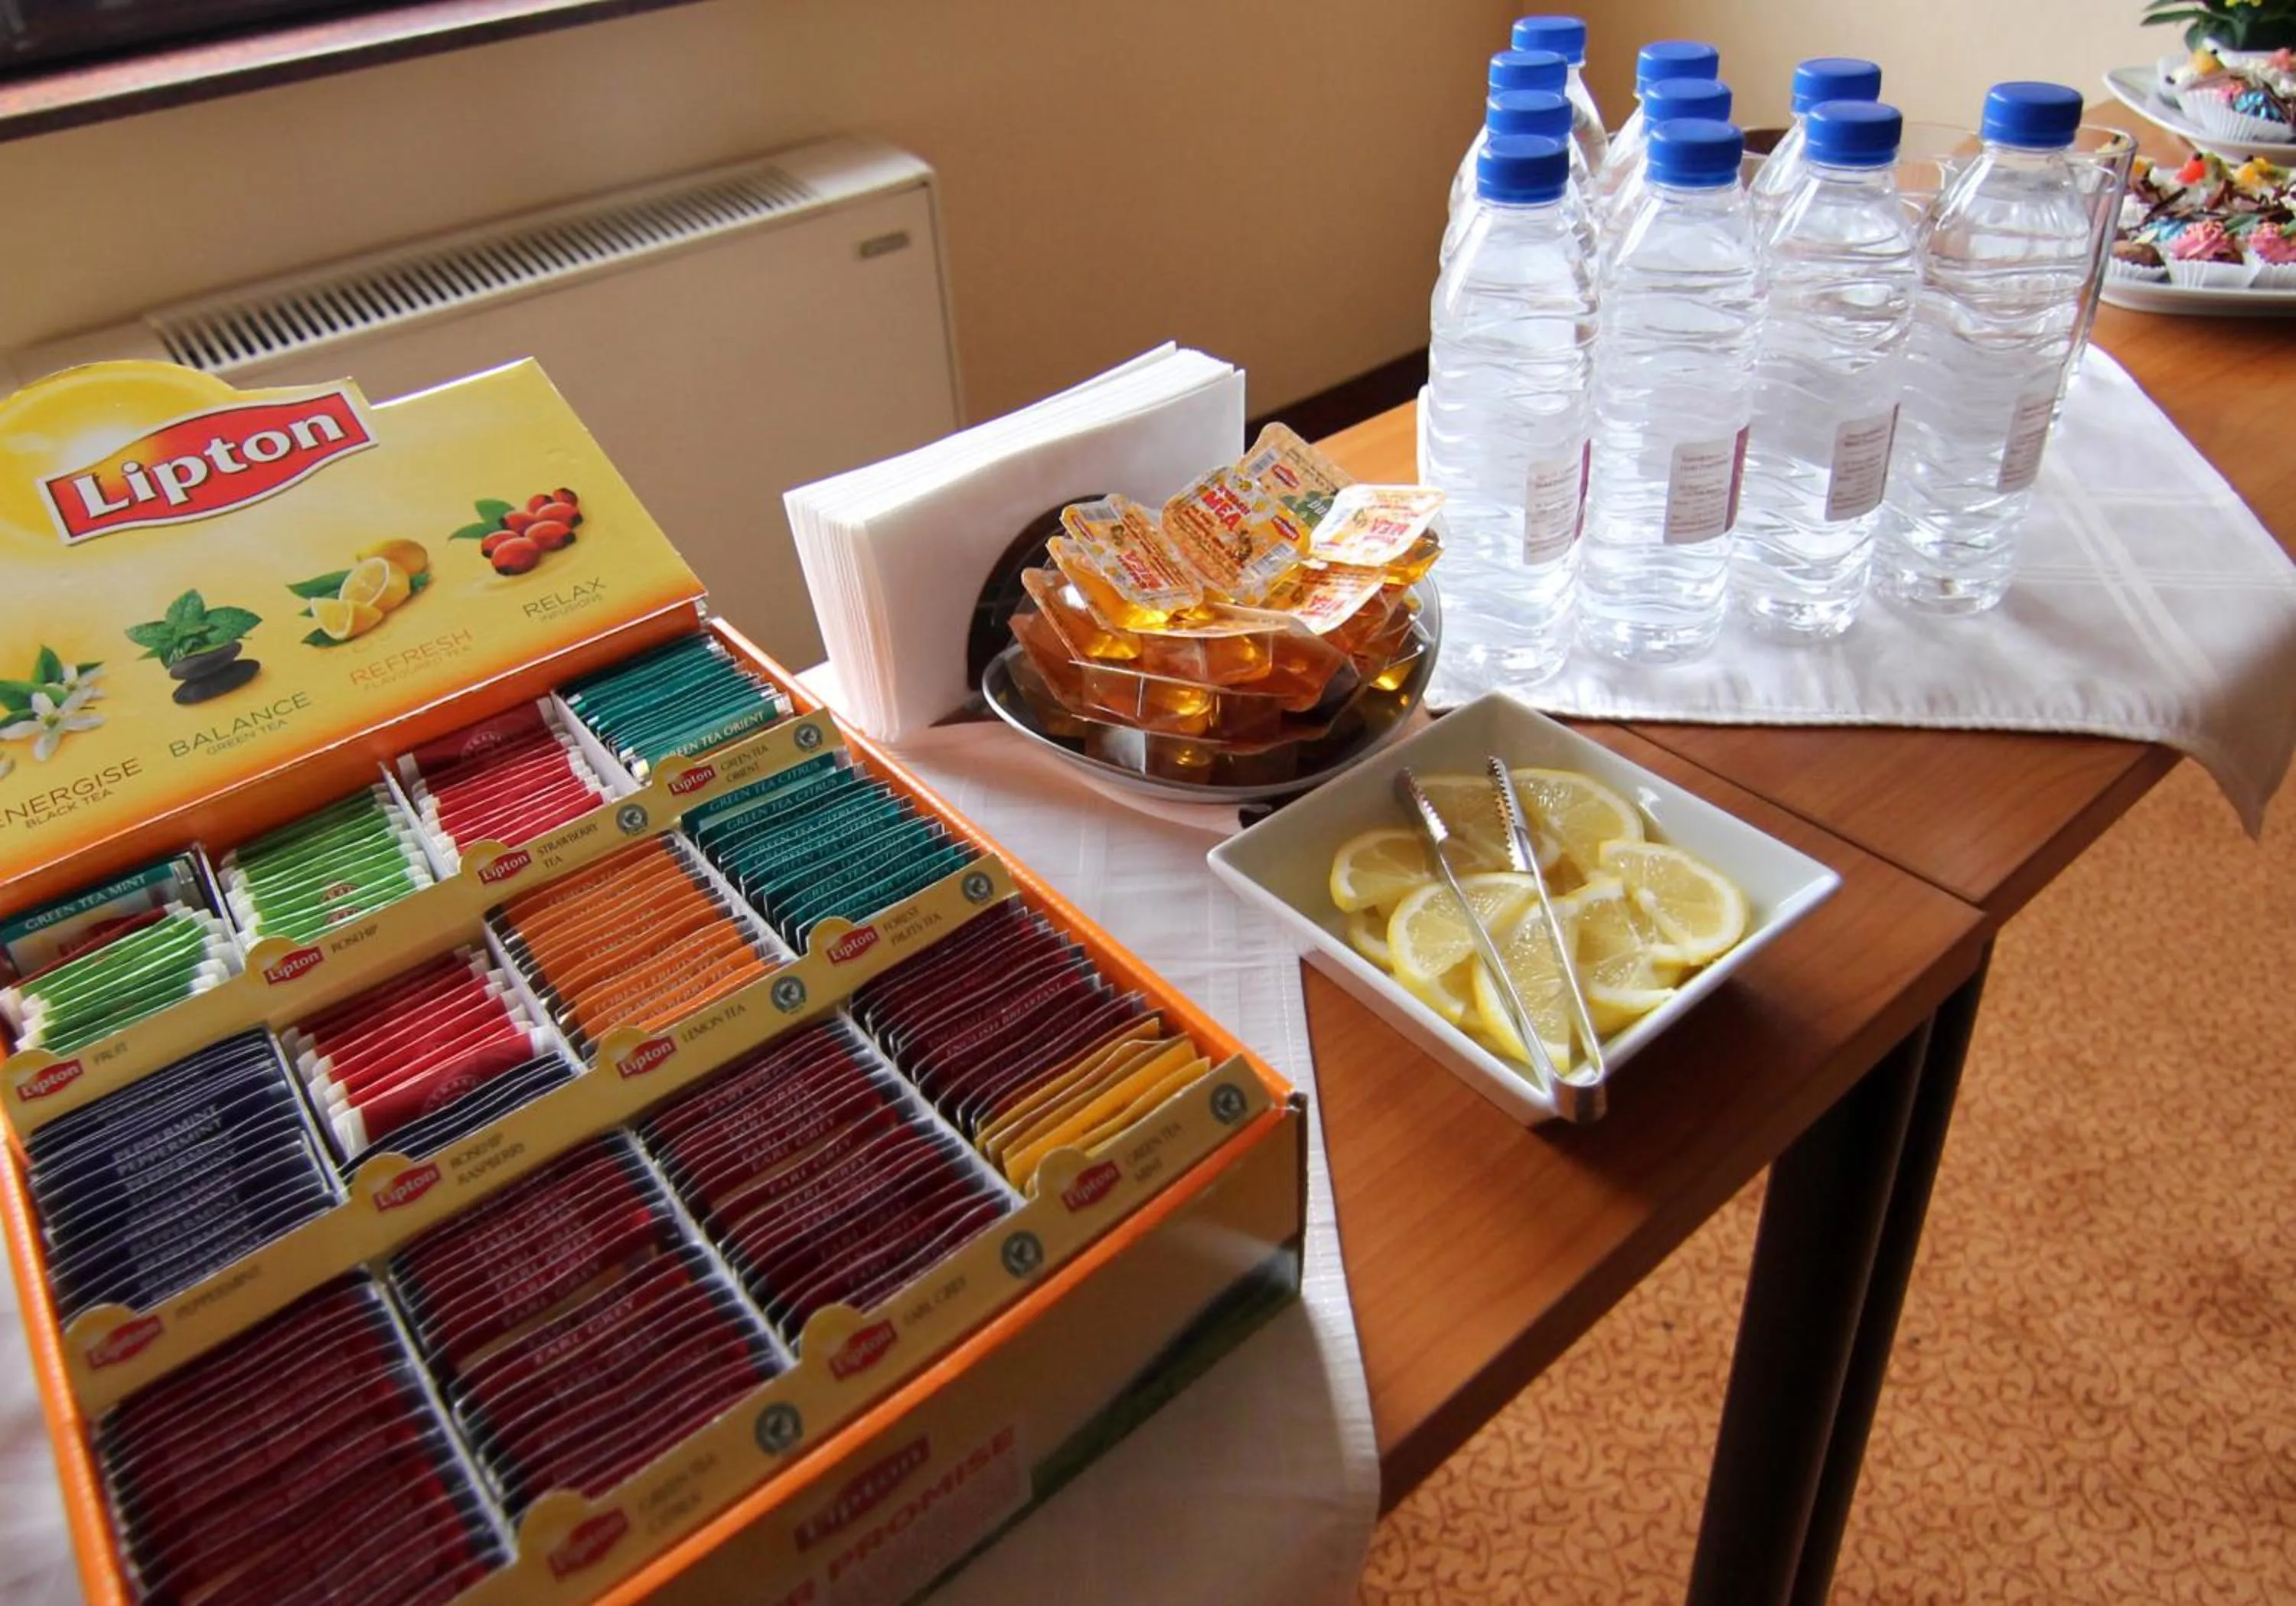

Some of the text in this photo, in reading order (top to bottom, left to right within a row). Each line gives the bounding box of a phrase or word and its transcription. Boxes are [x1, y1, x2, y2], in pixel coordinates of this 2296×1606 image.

[73, 413, 344, 518] Lipton
[522, 576, 607, 618] RELAX
[350, 629, 473, 685] REFRESH
[168, 691, 311, 758] BALANCE
[207, 720, 288, 756] GREEN TEA
[700, 731, 722, 747] TEA
[723, 710, 765, 736] ORIENT
[670, 769, 713, 793] Lipton
[707, 787, 751, 812] GREEN
[775, 758, 821, 784] CITRUS
[26, 788, 113, 829] BLACK TEA
[724, 805, 768, 831] GREEN
[793, 775, 838, 801] CITRUS
[538, 822, 598, 856] STRAWBERRY
[481, 853, 529, 881] Lipton
[544, 857, 563, 870] TEA
[24, 874, 146, 931] GREEN TEA MINT
[830, 927, 876, 961] Lipton
[268, 951, 320, 980] Lipton
[680, 1001, 748, 1043] LEMON TEA
[618, 1038, 673, 1075] Lipton
[21, 1065, 82, 1098] Lipton
[377, 1167, 438, 1208] Lipton
[1066, 1168, 1116, 1206] Lipton
[532, 1298, 635, 1366] EARL GREY
